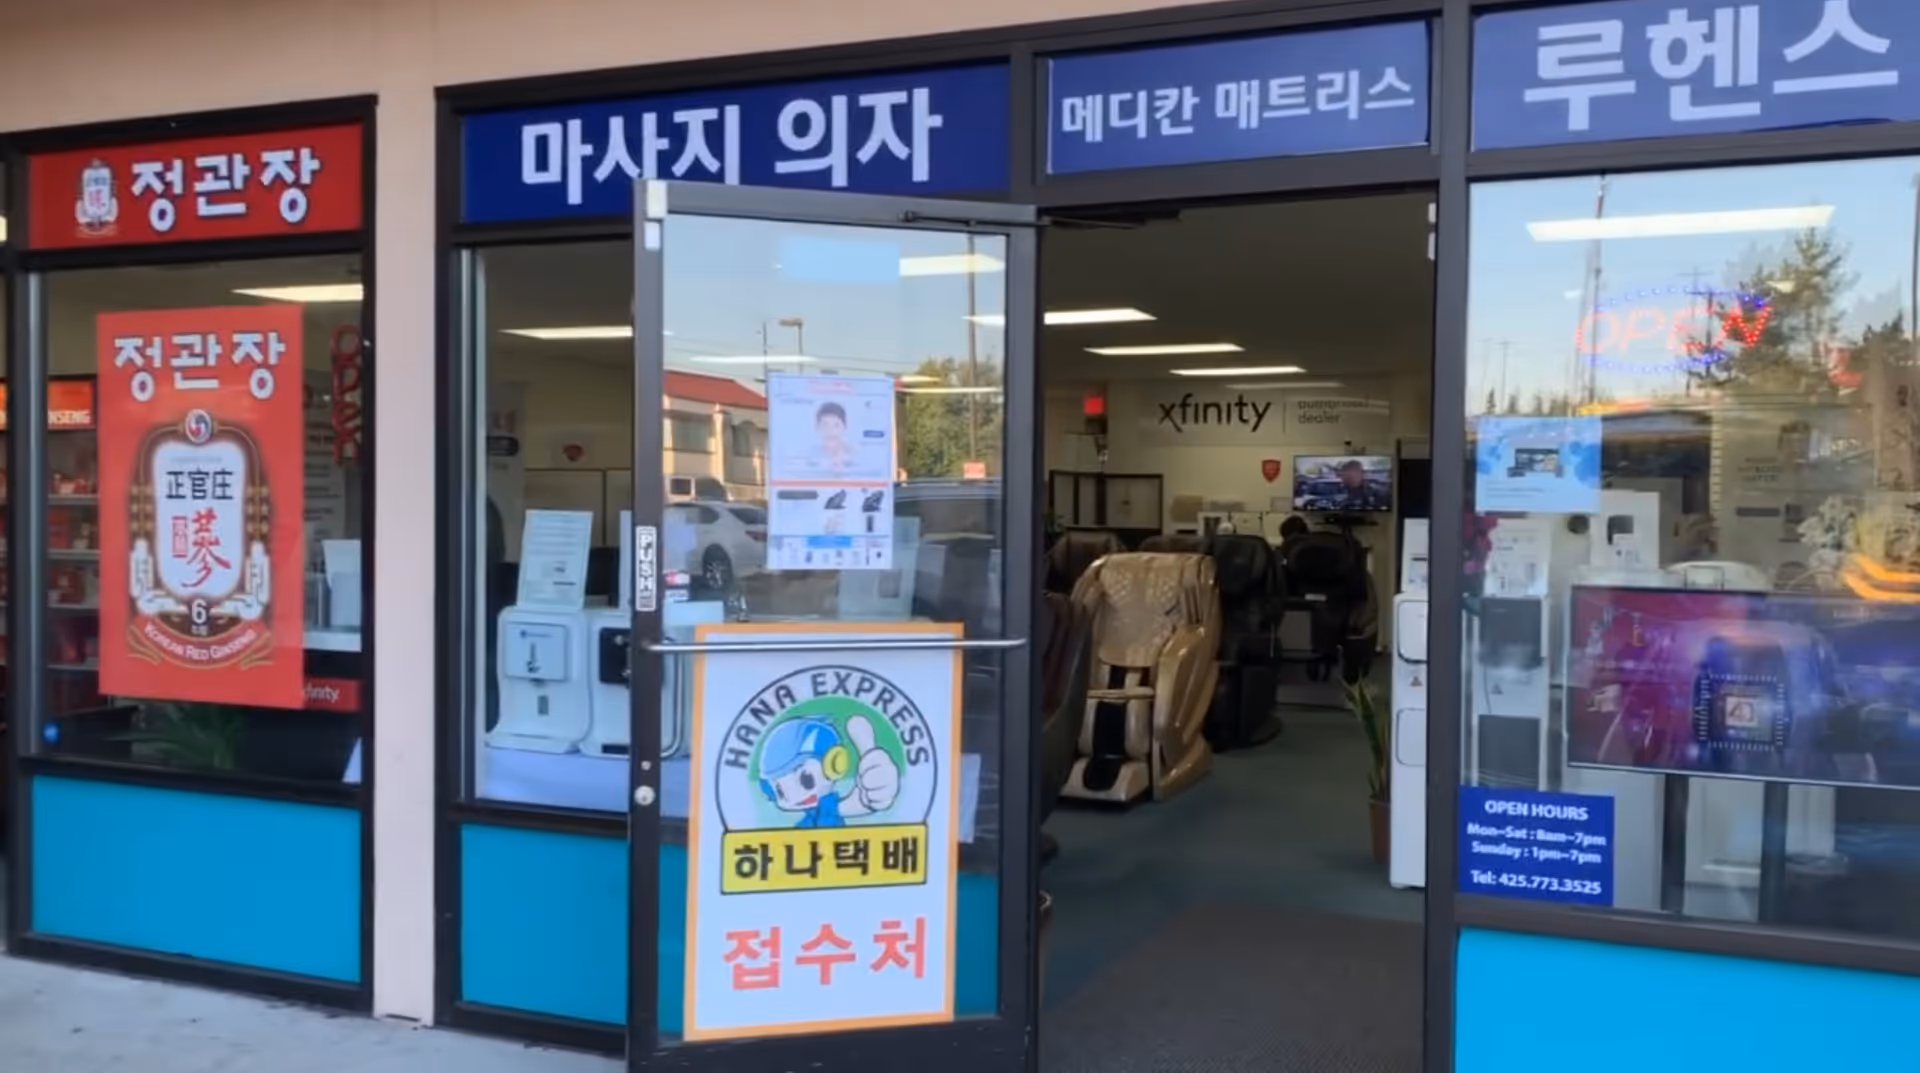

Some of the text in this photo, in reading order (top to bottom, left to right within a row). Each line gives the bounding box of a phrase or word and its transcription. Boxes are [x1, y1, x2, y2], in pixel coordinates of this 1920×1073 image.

[1524, 0, 1898, 131] 루헨스
[1062, 66, 1415, 142] 메디칸 매트리스
[521, 88, 943, 204] 마사지 의자
[131, 147, 321, 232] 정관장
[1574, 303, 1772, 355] OPEN
[114, 331, 286, 402] 정관장
[1158, 392, 1272, 434] xfinity
[165, 466, 234, 500] 正官庄
[639, 533, 653, 591] PUSH
[191, 598, 207, 624] 6
[724, 671, 929, 769] HANA EXPRESS
[1484, 800, 1589, 821] OPEN HOURS
[734, 836, 918, 881] 하나택배
[1470, 869, 1602, 895] Tel: 425.773.3525
[723, 916, 926, 991] 접수처
